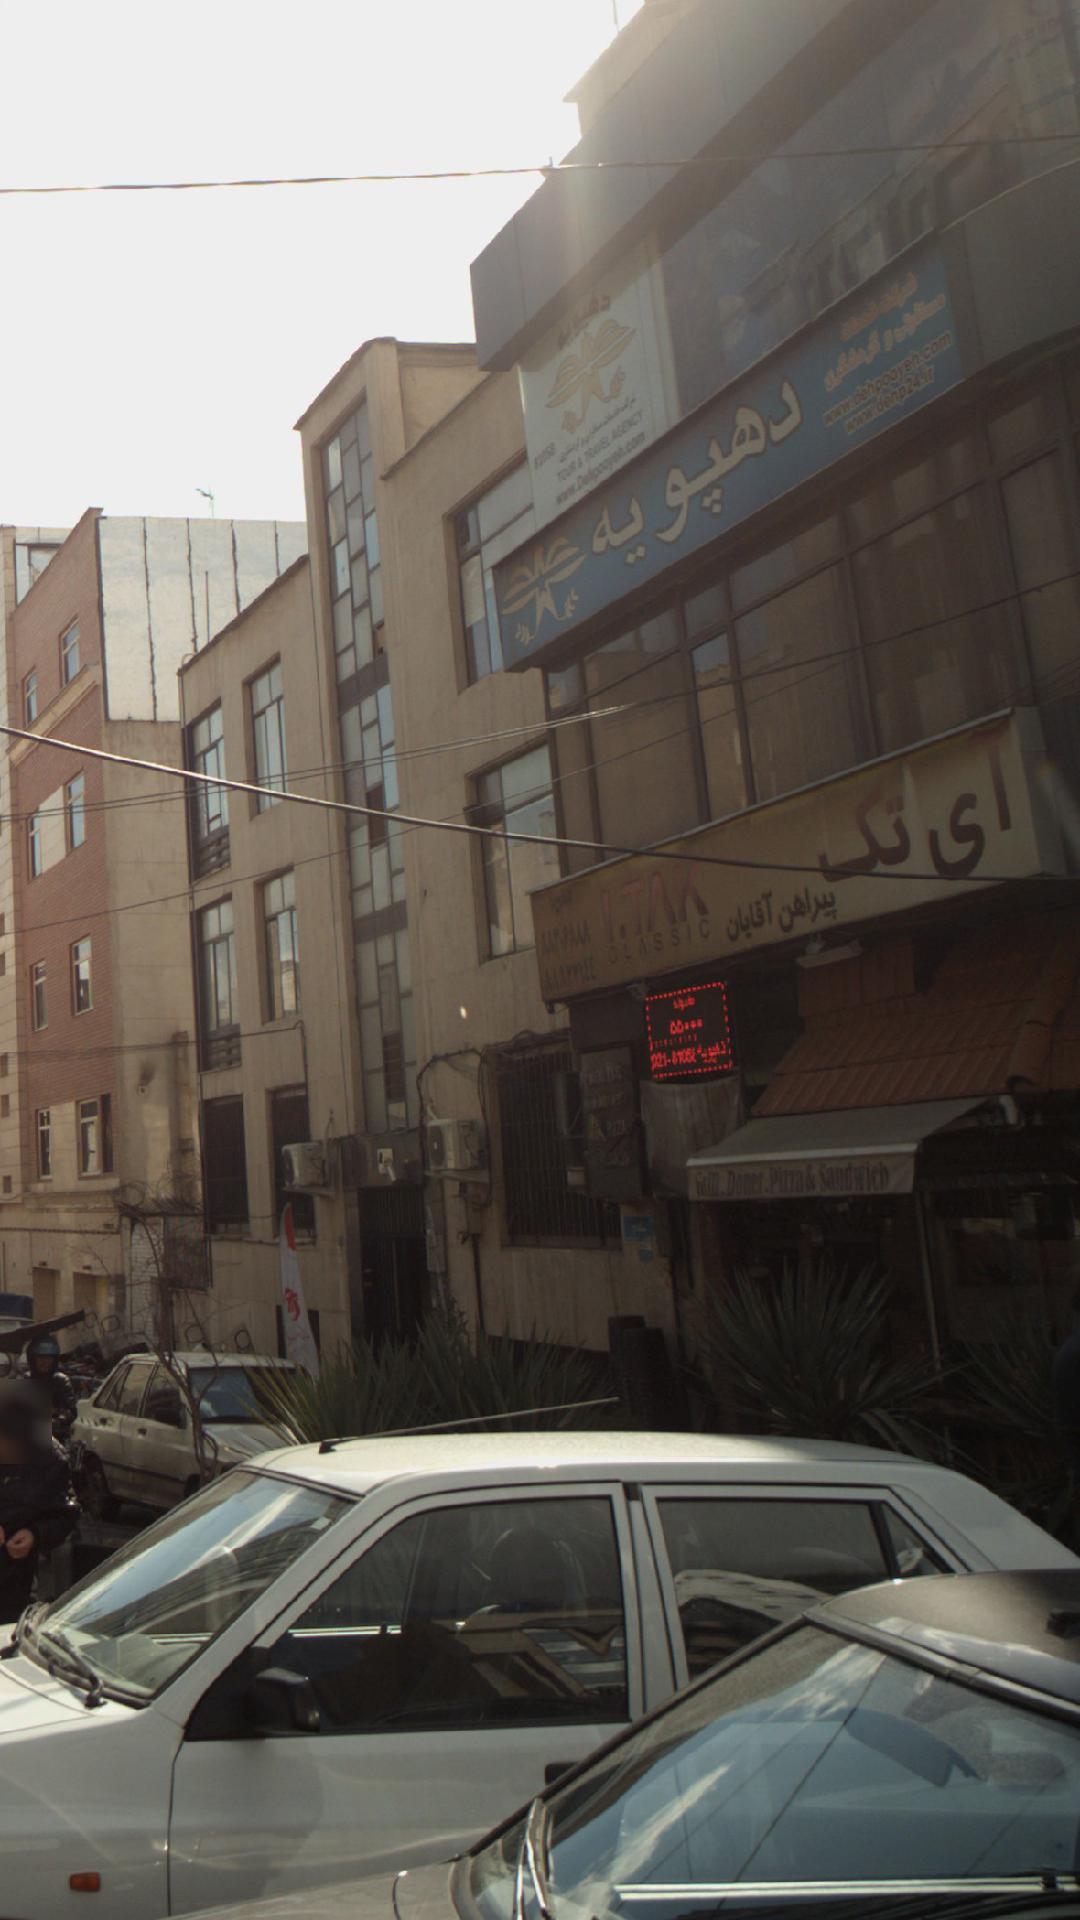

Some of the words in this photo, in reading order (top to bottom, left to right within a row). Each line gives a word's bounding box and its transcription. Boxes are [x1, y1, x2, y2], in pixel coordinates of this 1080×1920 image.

[611, 408, 645, 441] AGENCY
[590, 376, 805, 568] دهپویه
[726, 891, 775, 941] آقایان
[776, 885, 838, 932] پیراهن
[607, 917, 711, 965] CLASSIC
[819, 1160, 890, 1193] Sandwich
